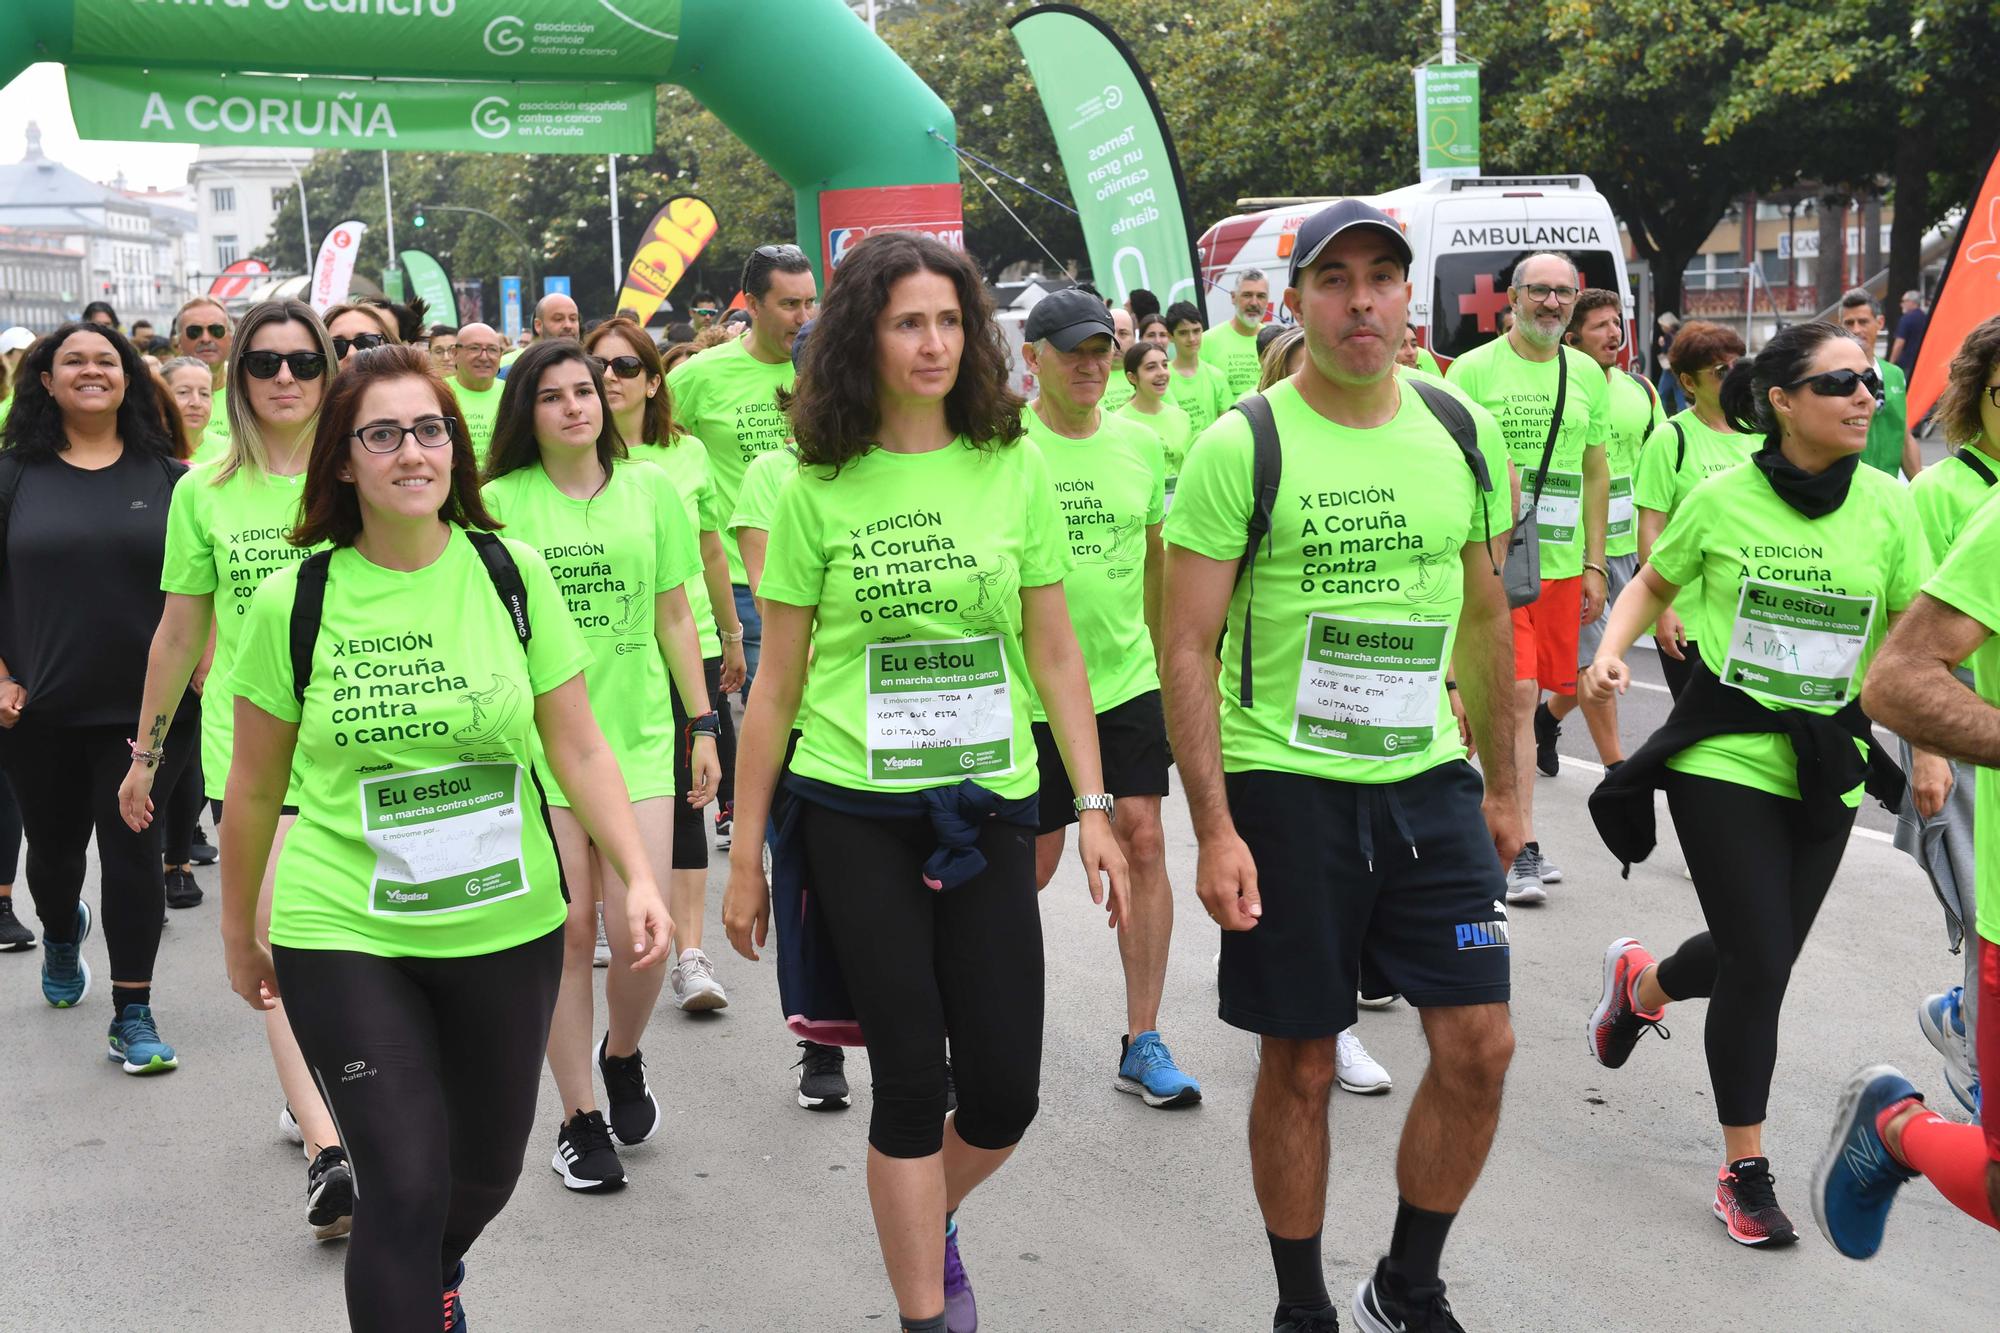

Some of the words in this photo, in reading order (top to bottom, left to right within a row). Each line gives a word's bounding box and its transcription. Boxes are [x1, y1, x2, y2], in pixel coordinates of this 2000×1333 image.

[534, 22, 594, 33] asociación
[140, 92, 175, 130] A
[185, 91, 398, 138] CORUÑA
[578, 101, 628, 112] española
[518, 114, 552, 123] contra
[518, 127, 533, 135] en
[535, 126, 542, 135] A
[544, 126, 584, 136] Coruña
[1451, 226, 1601, 247] AMBULANCIA
[736, 406, 742, 415] X
[1503, 407, 1511, 416] A
[736, 419, 745, 430] A
[1503, 419, 1518, 428] en
[737, 431, 753, 441] en
[1502, 429, 1542, 439] contra
[740, 441, 778, 452] contra
[1300, 495, 1312, 510] X
[1318, 486, 1395, 508] EDICIÓN
[850, 528, 861, 540] X
[866, 509, 942, 536] EDICIÓN
[1301, 518, 1318, 538] A
[1325, 511, 1407, 534] Coruña
[230, 534, 240, 544] X
[852, 543, 865, 561] A
[871, 534, 955, 557] Coruña
[1302, 544, 1333, 557] en
[1340, 532, 1424, 554] marcha
[229, 549, 240, 564] A
[544, 541, 604, 560] EDICIÓN
[1740, 546, 1750, 558] X
[1754, 544, 1823, 559] EDICIÓN
[230, 568, 251, 581] en
[550, 561, 612, 580] Coruña
[854, 566, 879, 580] en
[886, 552, 978, 577] marcha
[1303, 557, 1377, 575] contra
[1738, 565, 1750, 579] A
[1757, 565, 1831, 581] Coruña
[561, 578, 625, 596] marcha
[855, 576, 932, 602] contra
[1301, 580, 1315, 593] o
[1322, 577, 1400, 594] cancro
[237, 603, 245, 615] o
[860, 609, 873, 624] o
[878, 597, 958, 620] cancro
[1753, 589, 1777, 608] Eu
[1783, 597, 1835, 618] estou
[1750, 607, 1761, 617] en
[1763, 610, 1795, 622] marcha
[1796, 616, 1824, 627] contra
[1831, 622, 1860, 631] cancro
[333, 642, 345, 657] X
[350, 631, 434, 654] EDICIÓN
[1322, 625, 1350, 646] Eu
[1356, 631, 1414, 651] estou
[881, 654, 908, 672] Eu
[914, 652, 975, 670] estou
[1320, 648, 1332, 657] en
[1334, 651, 1372, 662] marcha
[1373, 655, 1403, 664] contra
[1412, 657, 1436, 665] cancro
[333, 665, 348, 681] A
[354, 658, 446, 680] Coruña
[881, 678, 893, 686] en
[895, 675, 933, 685] marcha
[935, 673, 967, 683] contra
[975, 671, 999, 680] cancro
[1376, 673, 1403, 684] TODA
[1408, 677, 1414, 685] A
[332, 685, 361, 702] en
[369, 675, 468, 698] marcha
[938, 694, 961, 702] TODA
[332, 701, 418, 724] contra
[335, 732, 348, 747] o
[355, 720, 449, 745] cancro
[378, 787, 406, 807] Eu
[413, 777, 472, 801] estou
[379, 813, 394, 823] en
[395, 804, 436, 820] marcha
[436, 798, 468, 814] contra
[468, 798, 475, 806] o
[474, 791, 504, 804] cancro
[341, 1067, 378, 1083] Kalenji
